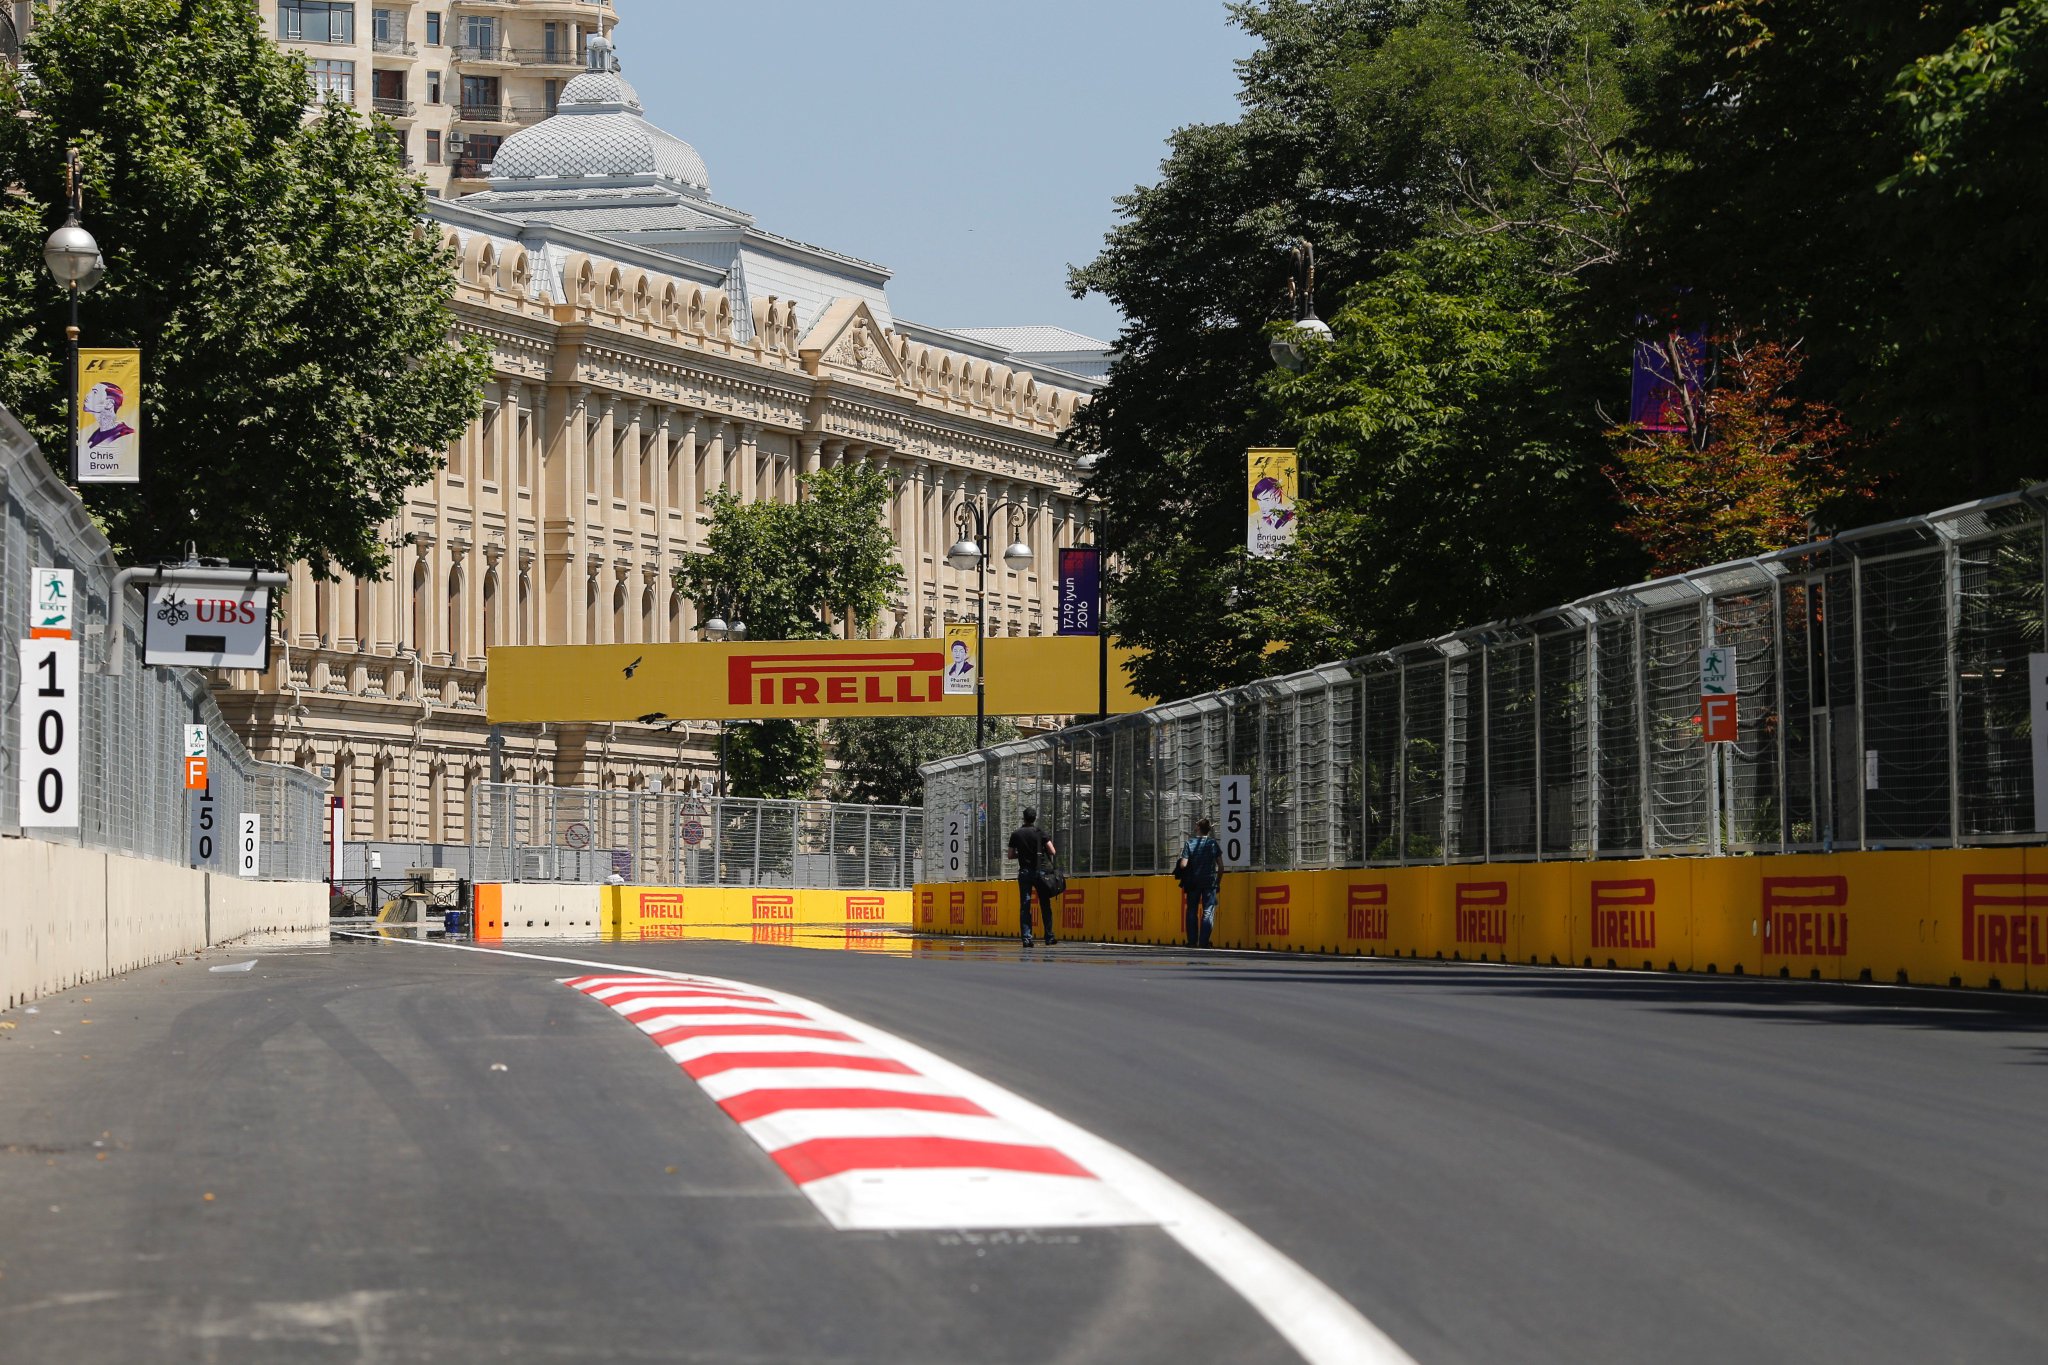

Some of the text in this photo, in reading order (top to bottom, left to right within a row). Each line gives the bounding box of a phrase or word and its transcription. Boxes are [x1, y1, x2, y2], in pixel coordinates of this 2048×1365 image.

[89, 451, 114, 460] Chris
[90, 461, 119, 470] Brown
[1257, 534, 1287, 543] Enrique
[40, 603, 68, 611] EXIT
[195, 598, 256, 625] UBS
[1063, 577, 1078, 629] 17-19 iyun
[1077, 601, 1089, 628] 2016
[728, 652, 945, 705] PIRELLI
[37, 651, 65, 814] 100
[1707, 700, 1729, 736] F
[190, 761, 204, 785] F
[1227, 781, 1242, 862] 150
[245, 820, 254, 869] 200
[949, 821, 959, 871] 200
[640, 893, 684, 919] PIRELLI
[752, 895, 794, 919] PIRELLI
[846, 896, 885, 920] PIRELLI
[1062, 888, 1085, 929] PIRELLI
[1118, 888, 1145, 931] PIRELLI
[1255, 885, 1291, 936] PIRELLI
[1347, 884, 1388, 940] PIRELLI
[1456, 881, 1508, 945] PIRELLI
[1591, 878, 1656, 949] PIRELLI
[1762, 875, 1849, 956] PIRELLI
[1962, 873, 2048, 965] PIREL
